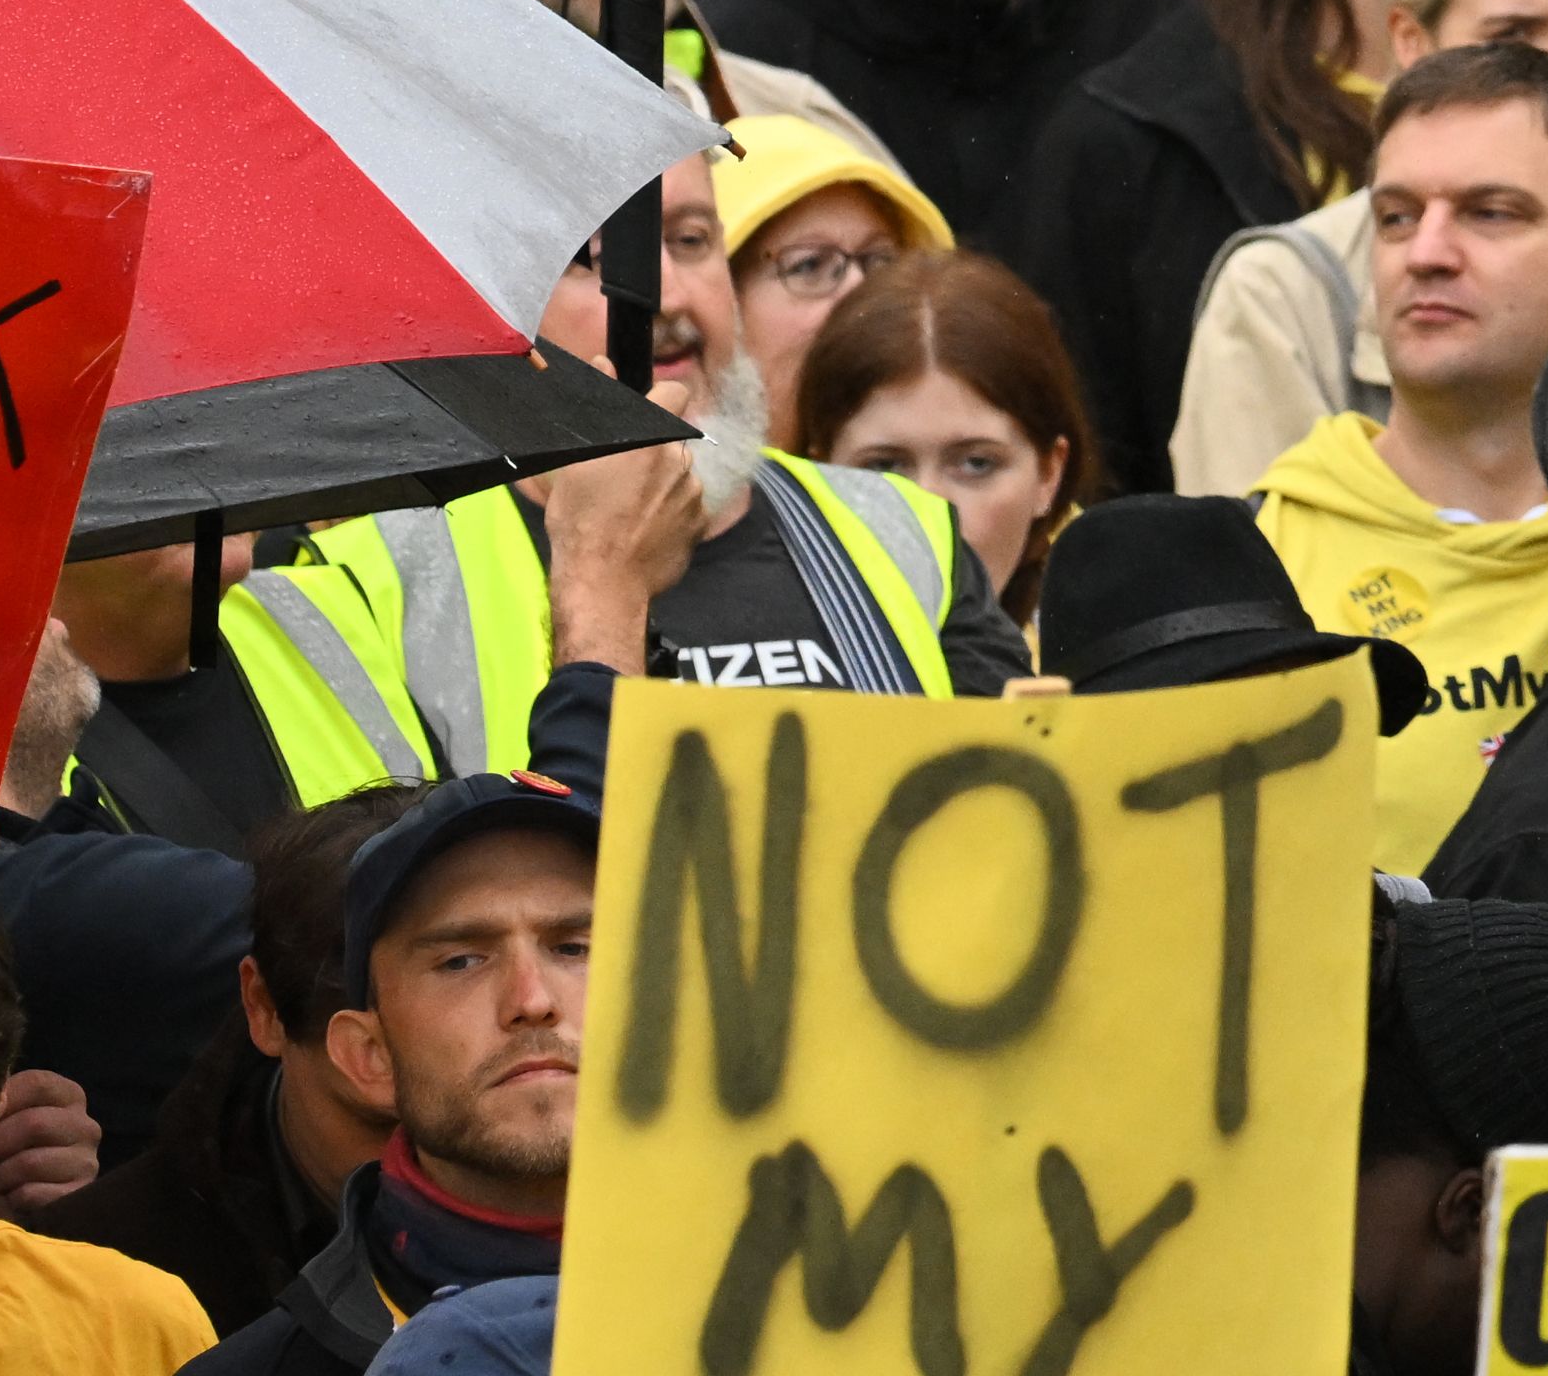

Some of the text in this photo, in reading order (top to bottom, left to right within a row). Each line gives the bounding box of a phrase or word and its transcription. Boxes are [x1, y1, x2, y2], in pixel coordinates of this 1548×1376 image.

[1348, 573, 1393, 603] NOT
[1367, 595, 1399, 617] MY
[1369, 609, 1424, 639] KING
[612, 697, 1346, 1136] NOT
